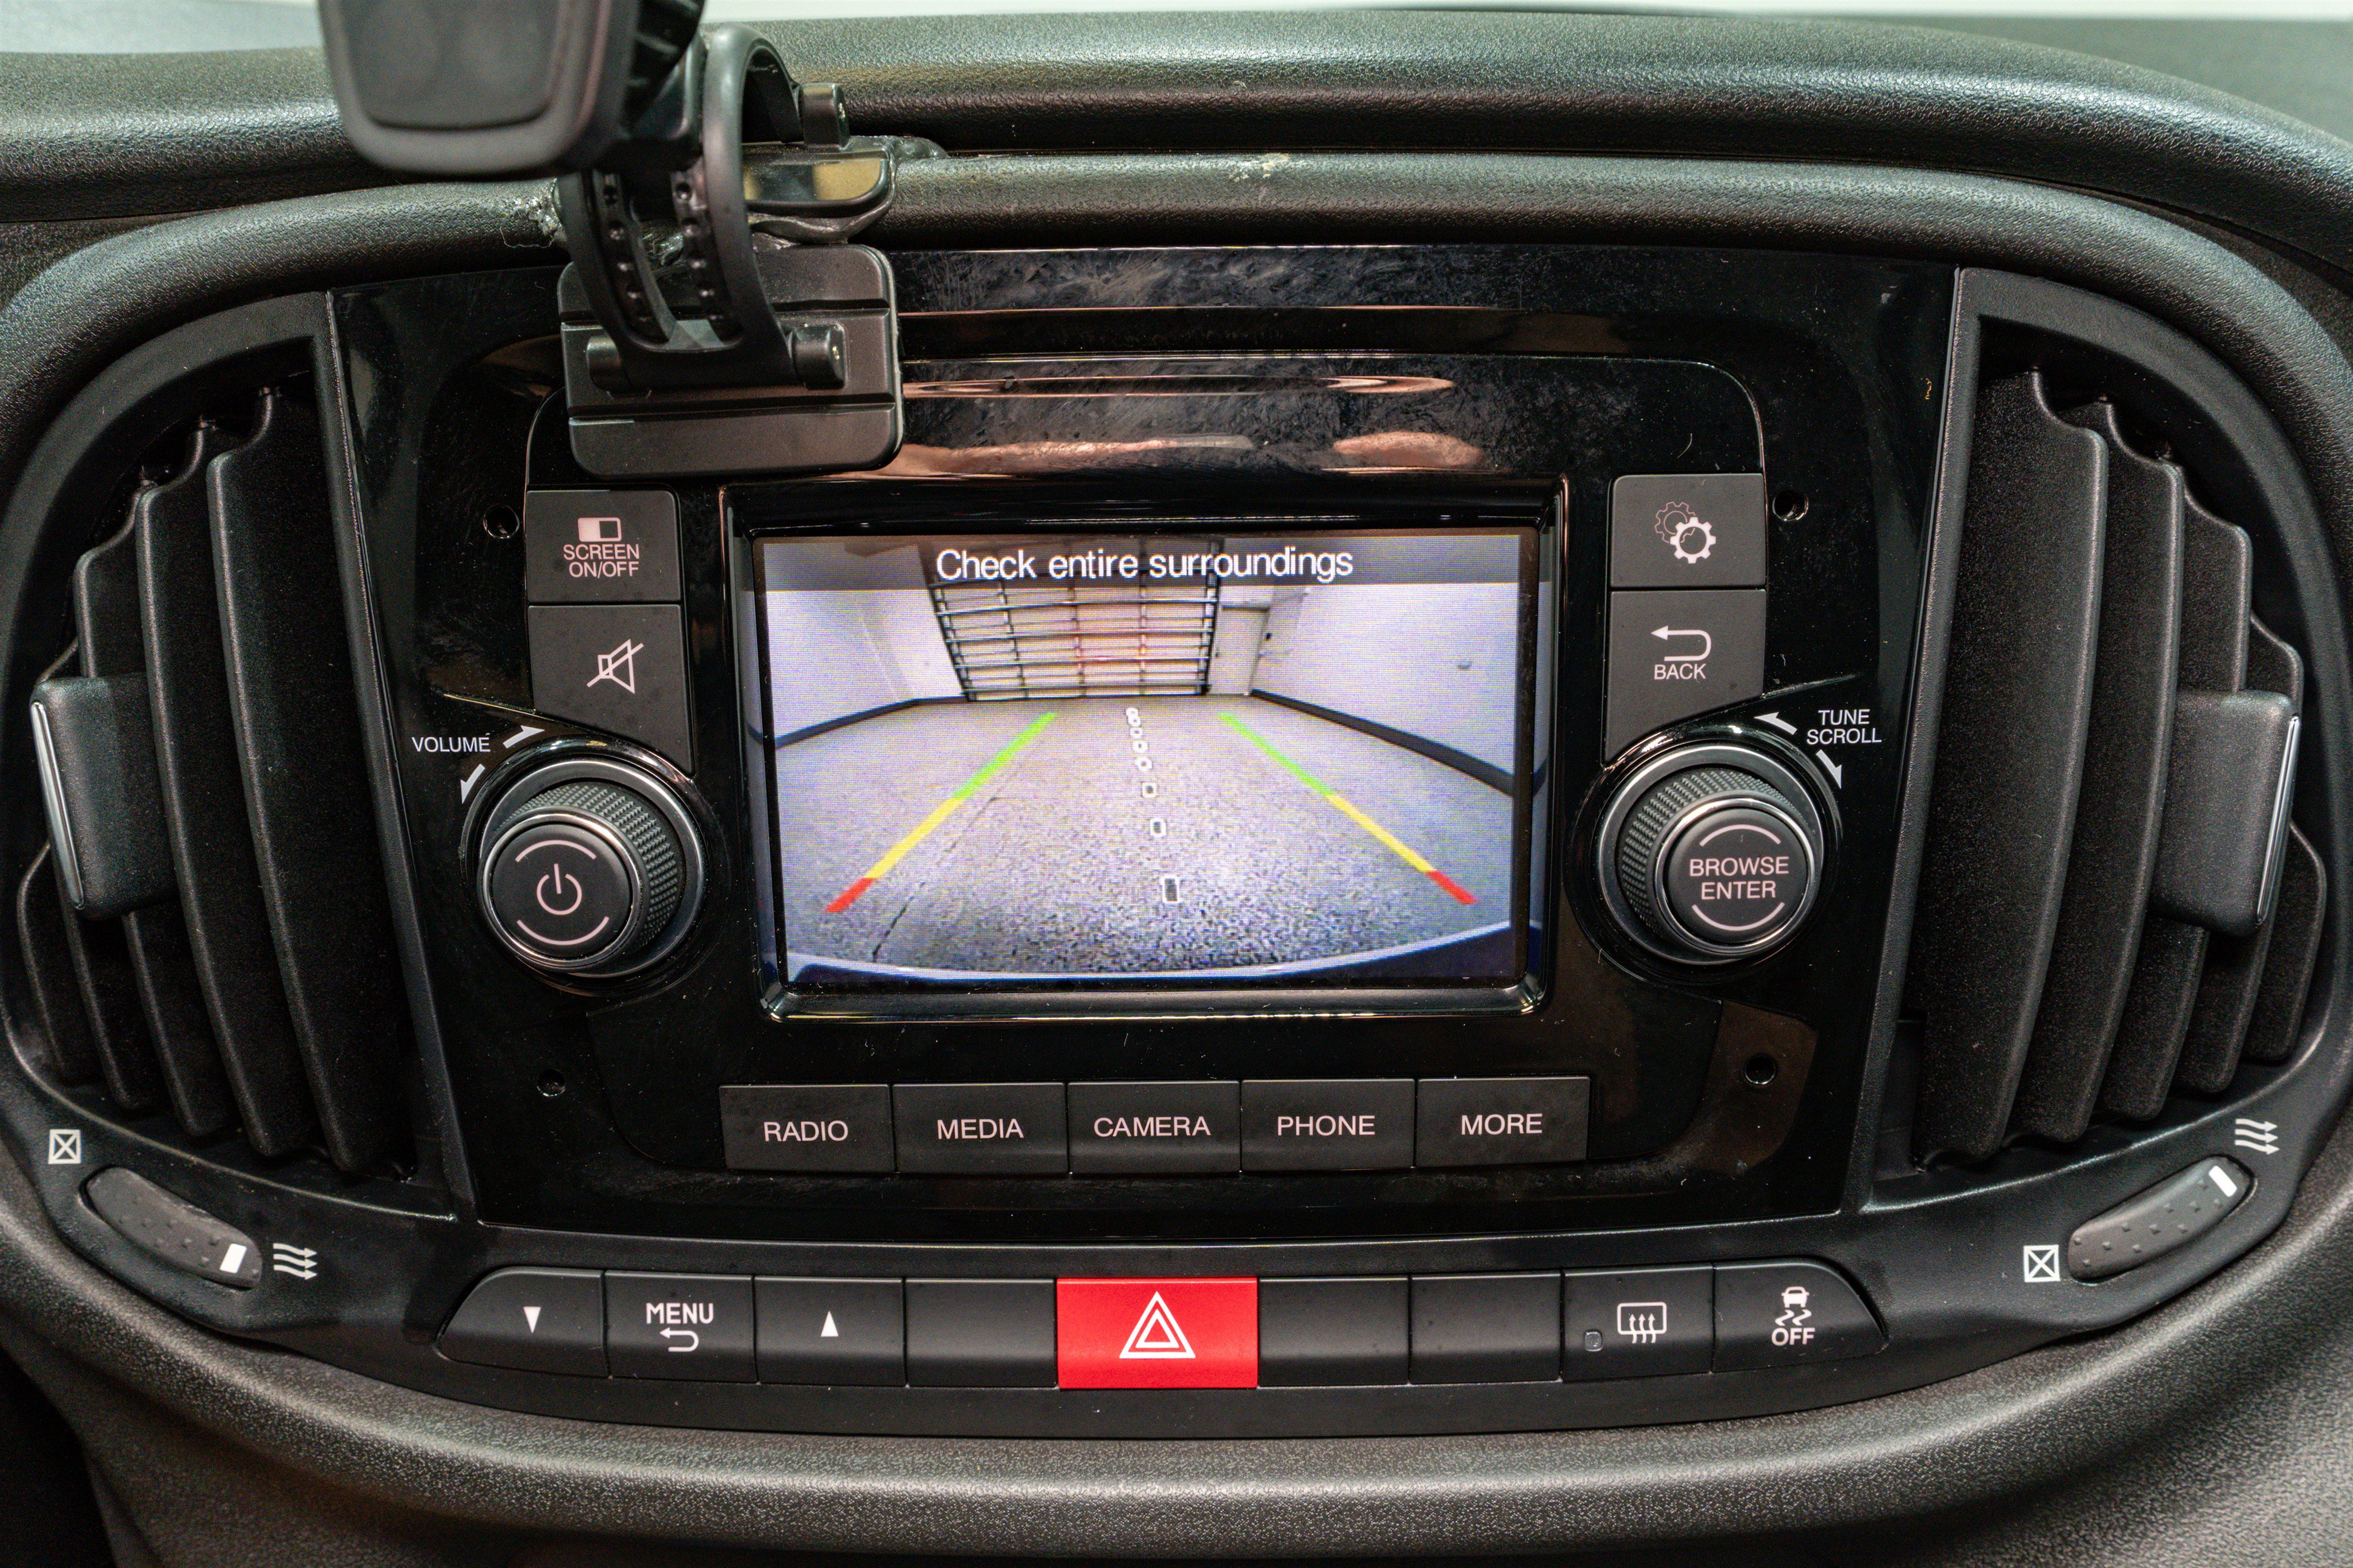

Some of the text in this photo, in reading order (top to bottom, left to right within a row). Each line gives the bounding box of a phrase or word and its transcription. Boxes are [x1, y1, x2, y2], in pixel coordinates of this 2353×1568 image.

[563, 543, 640, 561] SCREEN
[569, 561, 639, 578] ON/OFF
[936, 546, 1354, 582] Check entire surroundings
[1654, 663, 1707, 680] BACK
[1818, 709, 1870, 725] TUNE
[411, 736, 491, 752] VOLUME
[1807, 728, 1882, 745] SCROLL
[1689, 856, 1789, 876] BROWSE
[1701, 880, 1776, 900] ENTER
[763, 1120, 848, 1142] RADIO
[937, 1118, 1024, 1140] MEDIA
[1094, 1116, 1211, 1137] CAMERA
[1278, 1115, 1375, 1136] PHONE
[1461, 1113, 1542, 1135] MORE
[646, 1302, 714, 1324] MENU
[1771, 1327, 1816, 1346] OFF
